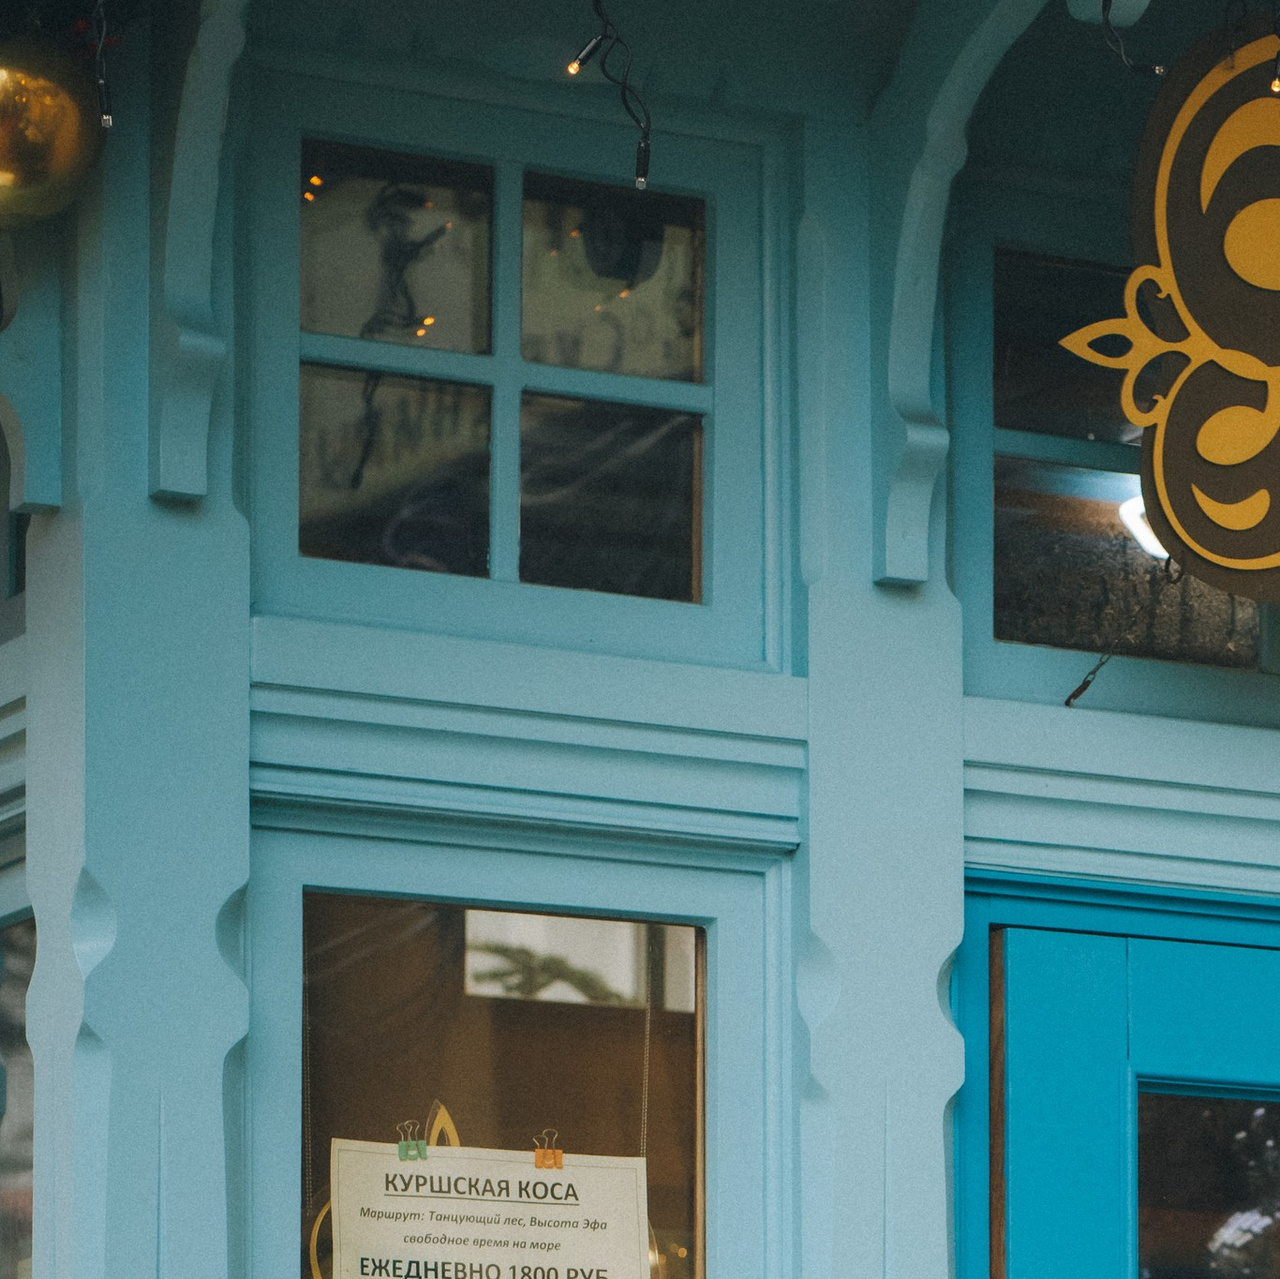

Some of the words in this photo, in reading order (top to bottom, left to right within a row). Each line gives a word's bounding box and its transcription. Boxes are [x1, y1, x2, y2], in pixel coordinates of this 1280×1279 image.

[384, 1172, 511, 1199] КУРШСКАЯ
[518, 1180, 580, 1201] КОСА
[359, 1206, 425, 1223] Маршрут:
[428, 1211, 501, 1227] Танцующий
[503, 1216, 527, 1229] лес,
[529, 1216, 580, 1230] Высота
[582, 1218, 608, 1233] Эфа
[403, 1233, 470, 1247] свободное
[472, 1237, 510, 1251] время
[512, 1240, 527, 1250] на
[528, 1240, 562, 1252] море
